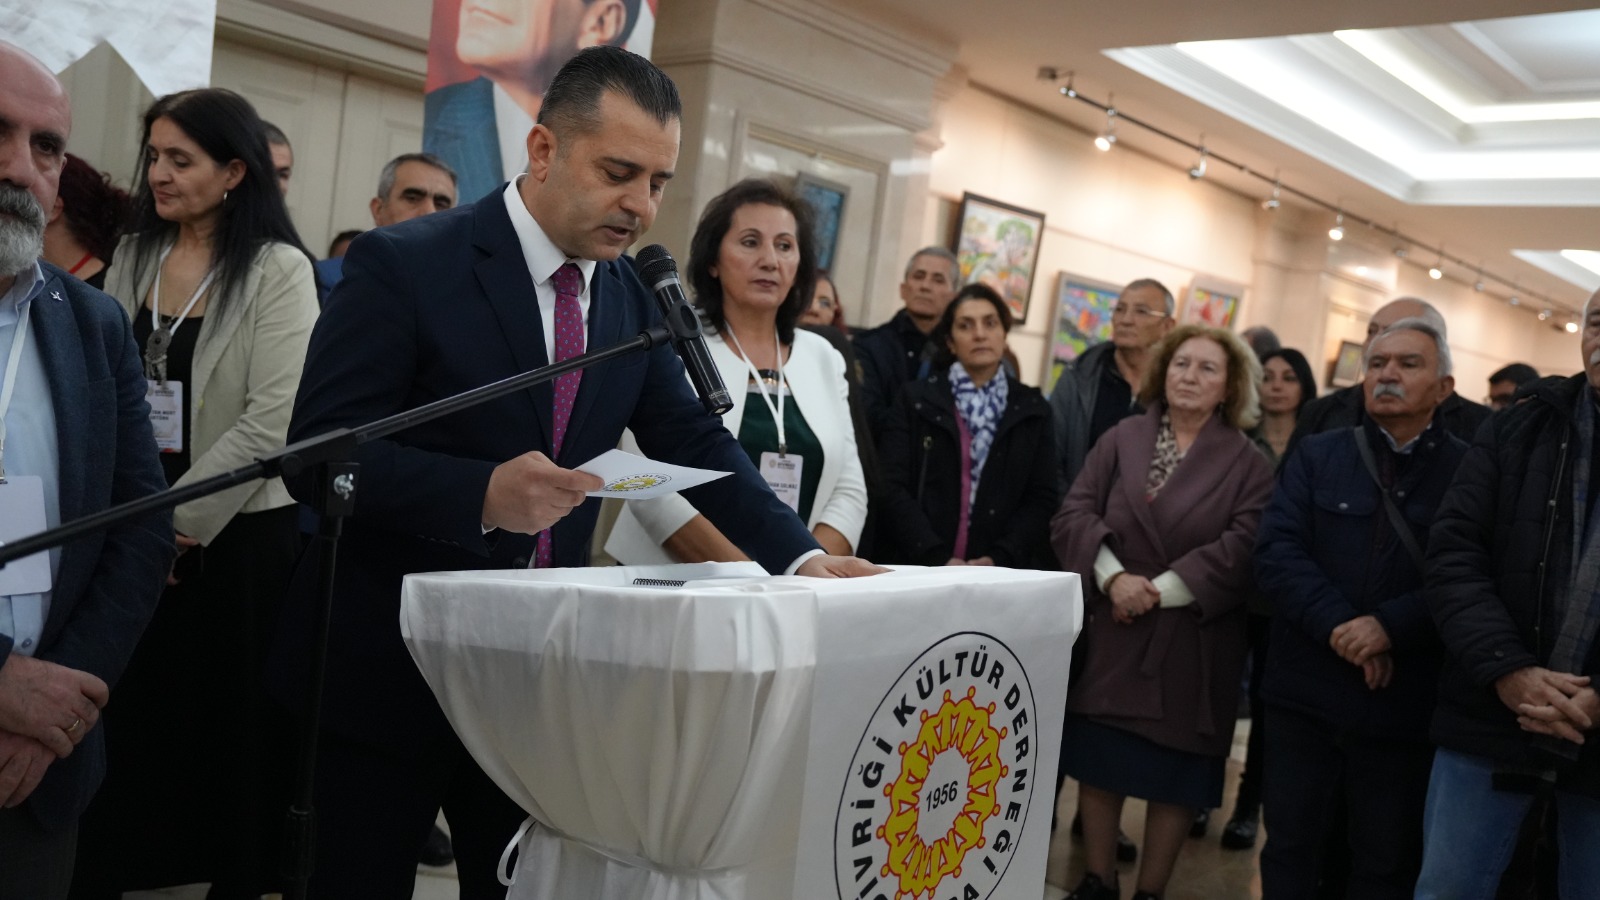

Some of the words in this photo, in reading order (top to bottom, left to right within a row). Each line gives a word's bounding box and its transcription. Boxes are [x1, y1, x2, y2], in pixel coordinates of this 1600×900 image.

[850, 735, 893, 900] İVRİĞİ
[893, 645, 1005, 728] KÜLTÜR
[982, 683, 1029, 876] DERNEĞİ
[926, 781, 959, 812] 1956
